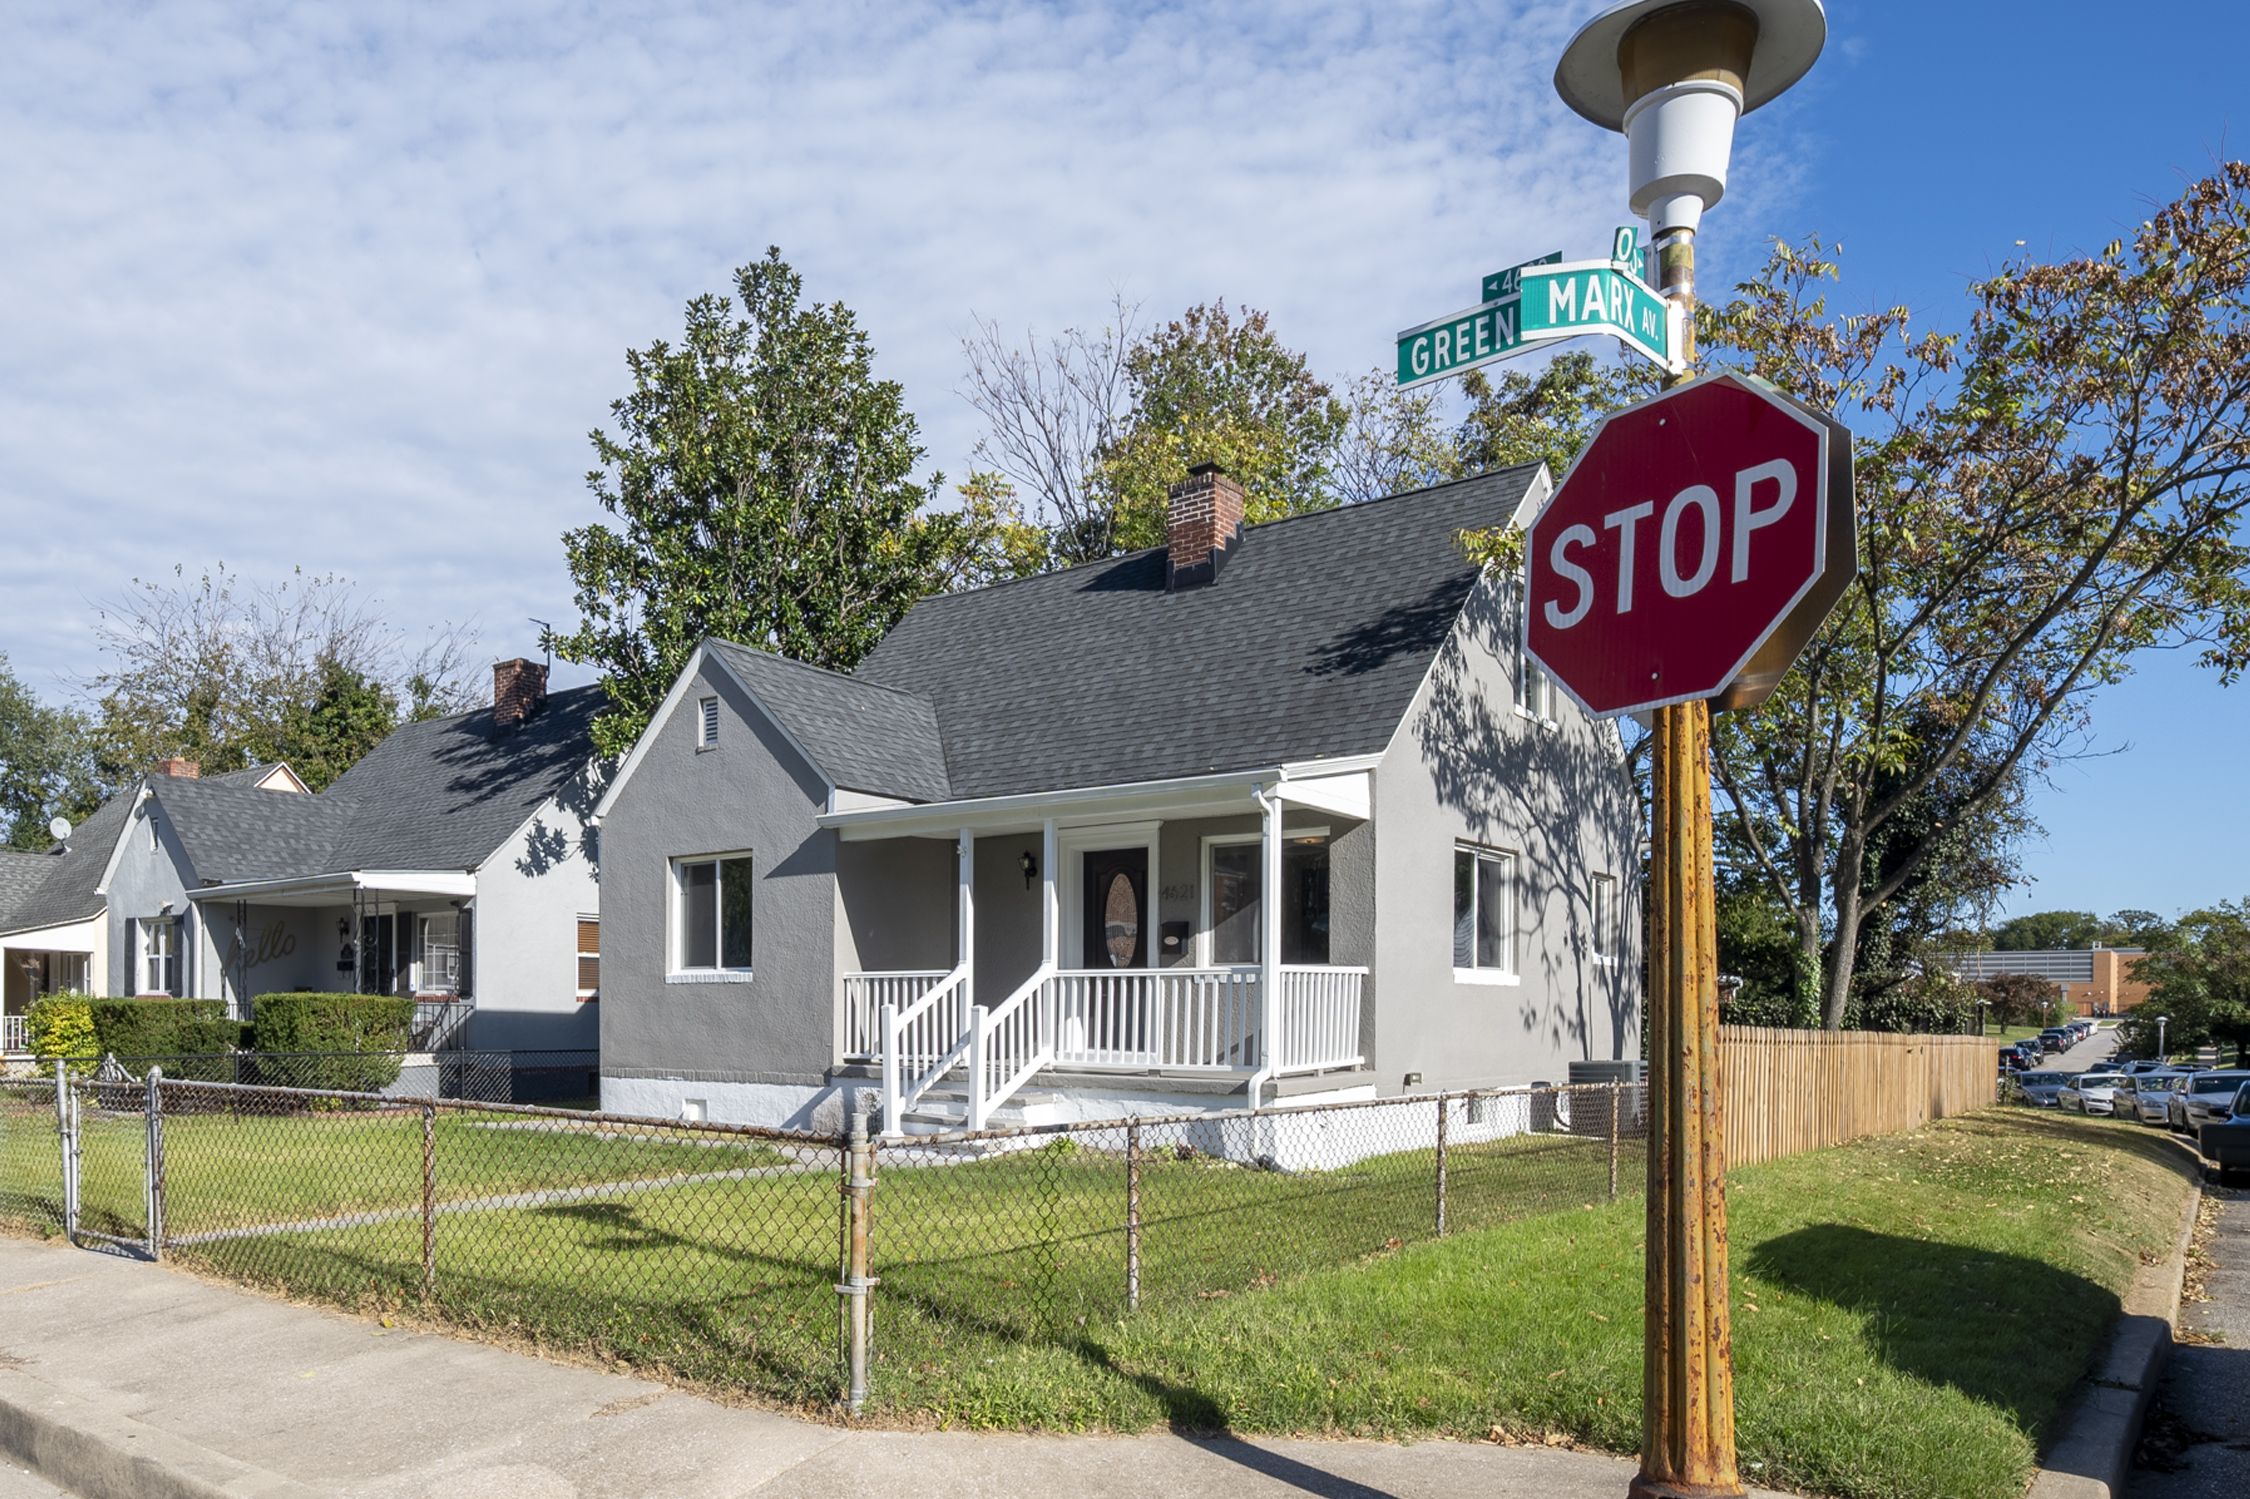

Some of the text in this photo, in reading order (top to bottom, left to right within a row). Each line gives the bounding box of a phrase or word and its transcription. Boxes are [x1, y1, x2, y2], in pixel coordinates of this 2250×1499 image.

[1411, 306, 1514, 376] GREEN
[1549, 274, 1659, 342] MARX AV.
[1544, 458, 1798, 630] STOP
[1161, 884, 1194, 900] 4621
